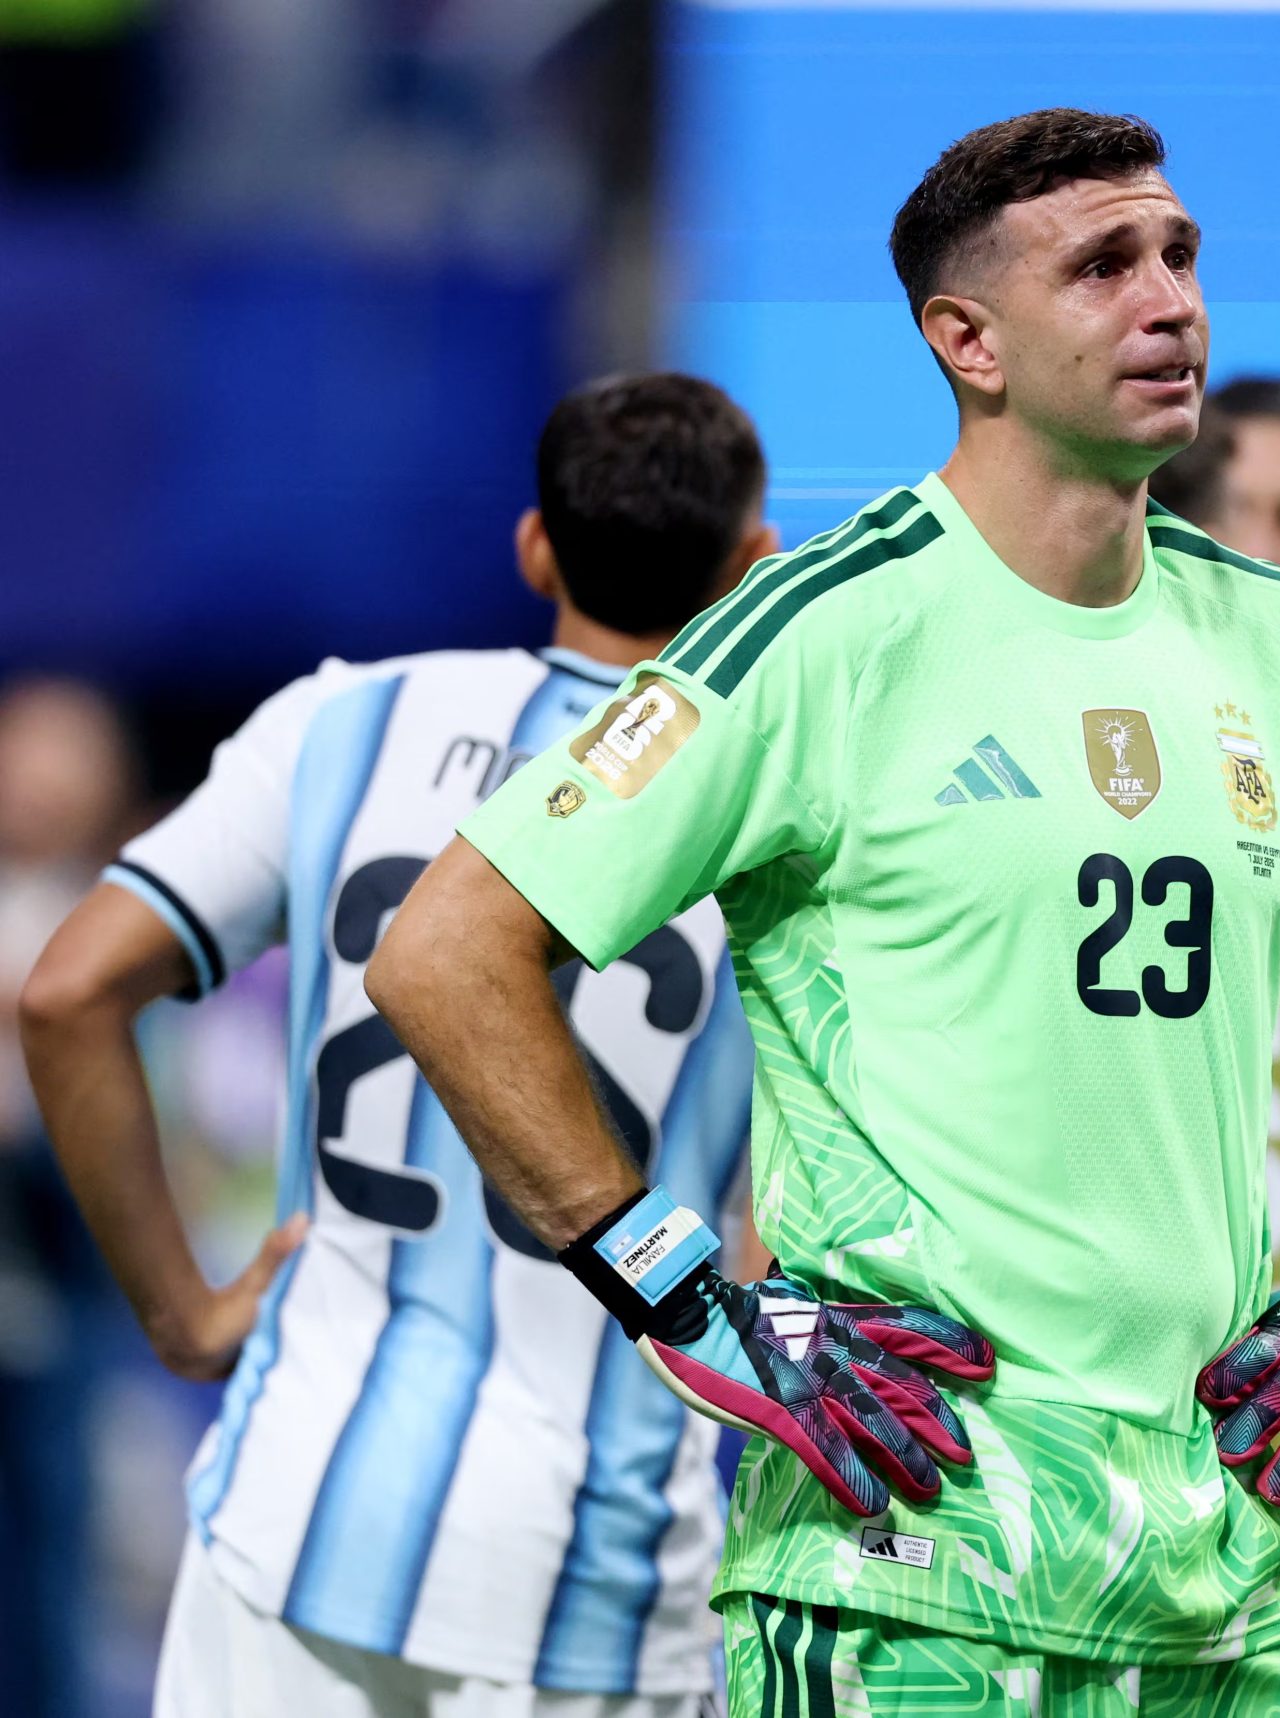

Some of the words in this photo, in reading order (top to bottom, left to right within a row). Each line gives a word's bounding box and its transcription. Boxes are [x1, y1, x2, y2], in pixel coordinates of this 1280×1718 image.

[612, 733, 631, 752] FIFA
[585, 747, 621, 780] 2026
[1109, 777, 1144, 792] FIFA
[1117, 797, 1138, 806] 2022
[1236, 840, 1262, 854] ARGENTINA
[1253, 854, 1263, 865] JULY
[1264, 856, 1275, 868] 2026
[1077, 852, 1214, 1019] 23
[623, 1226, 669, 1268] MARTÍNEZ
[632, 1244, 666, 1275] FAMILIA
[904, 1540, 928, 1549] AUTHENTIC
[905, 1554, 925, 1563] PRODUCT
